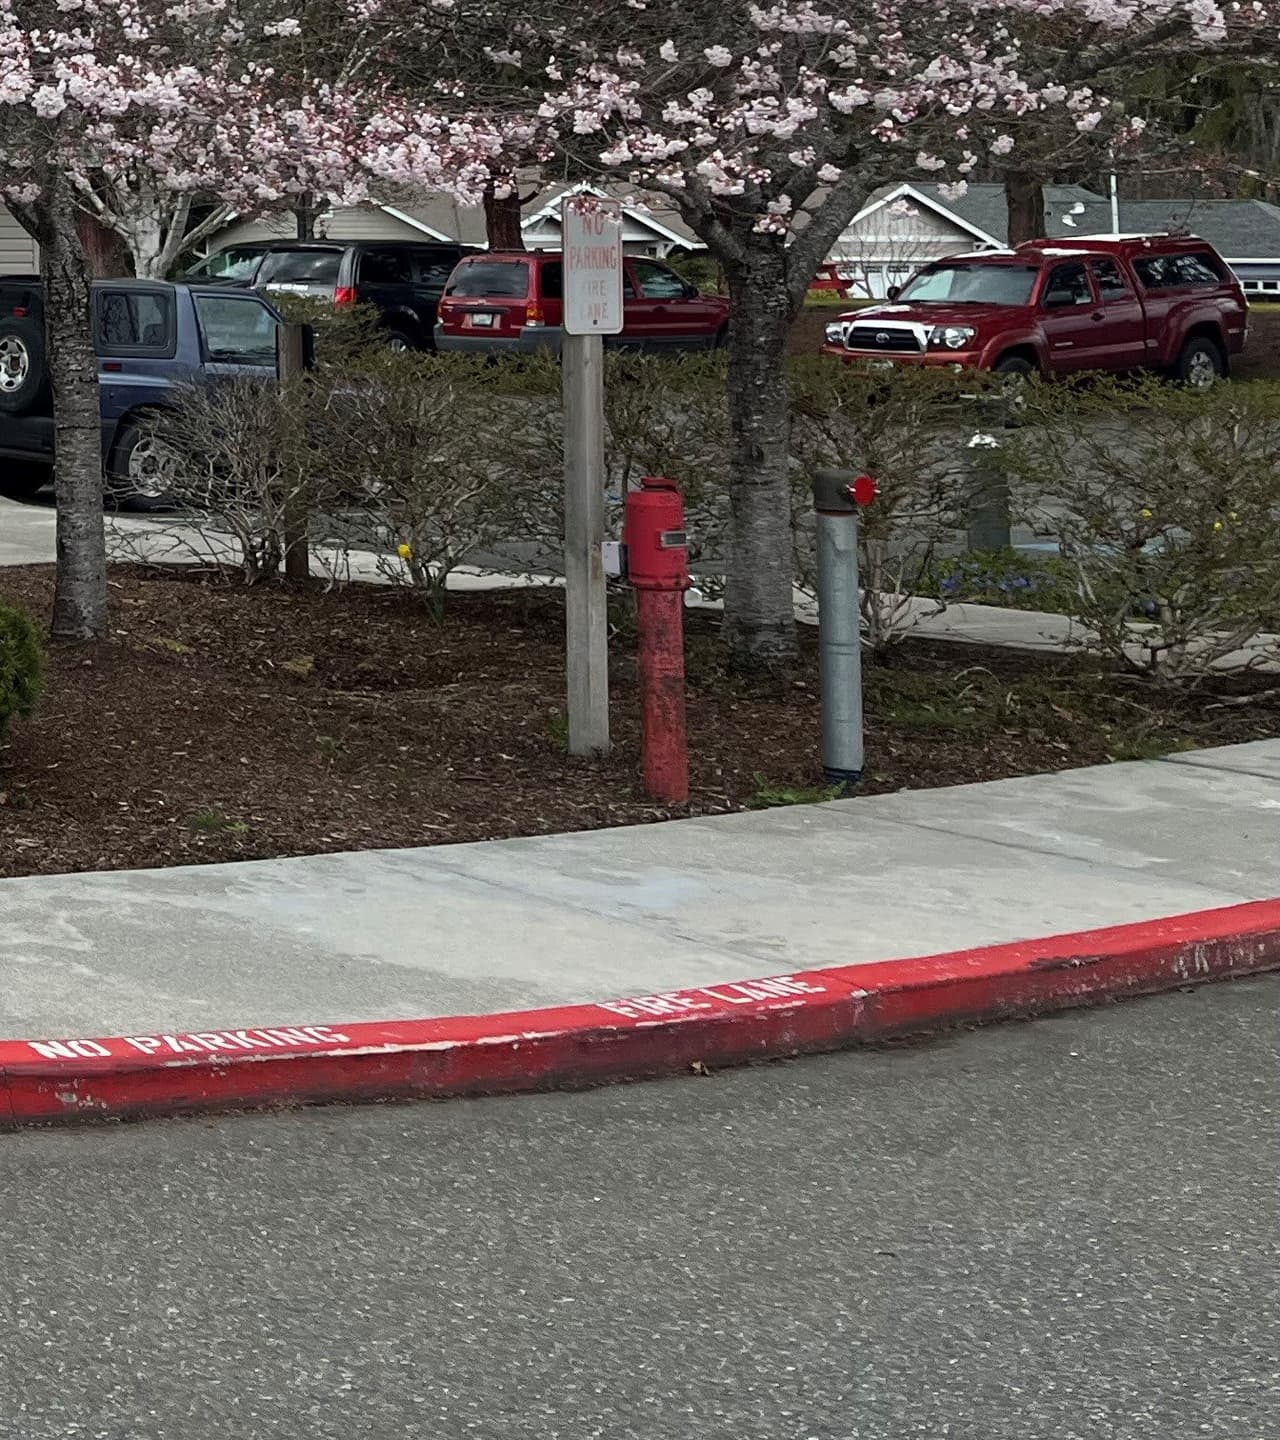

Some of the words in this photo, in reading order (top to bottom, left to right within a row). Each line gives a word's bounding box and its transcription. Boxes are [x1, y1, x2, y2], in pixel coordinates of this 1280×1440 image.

[583, 212, 605, 235] NO
[569, 246, 617, 271] PARKING
[597, 993, 712, 1018] FIRE
[700, 976, 827, 1004] LANE
[28, 1039, 112, 1059] NO
[124, 1026, 350, 1055] PARKING
